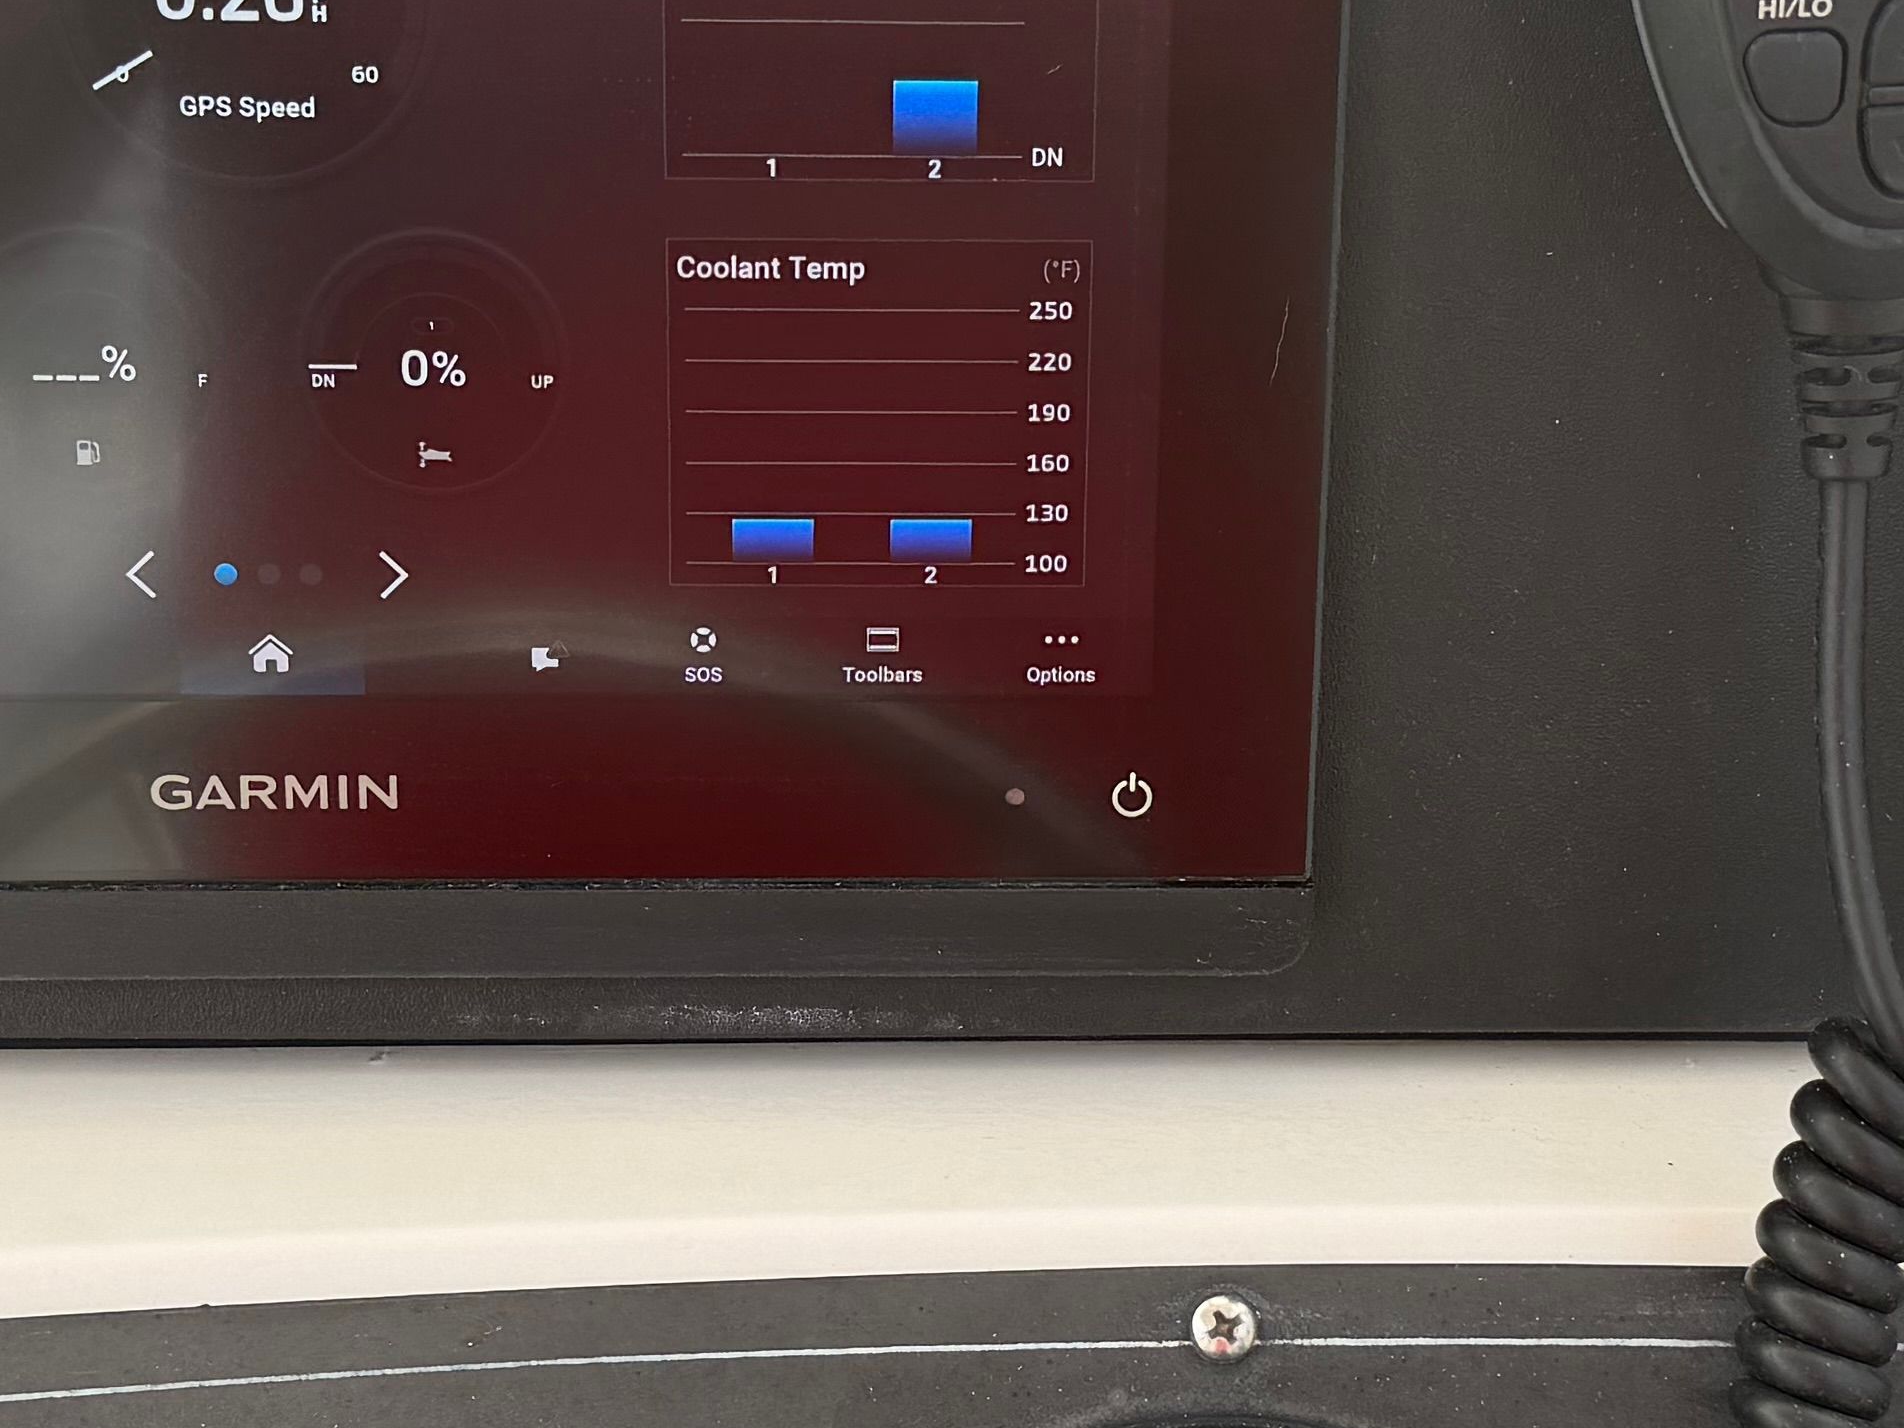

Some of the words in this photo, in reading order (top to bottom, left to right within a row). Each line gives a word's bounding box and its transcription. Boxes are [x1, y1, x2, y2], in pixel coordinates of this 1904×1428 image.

[352, 66, 378, 84] 60
[180, 97, 231, 117] GPS
[240, 97, 315, 122] Speed
[1032, 148, 1064, 168] DN
[676, 257, 780, 280] Coolant
[790, 257, 865, 285] Temp
[1029, 302, 1072, 321] 250
[312, 374, 335, 389] DN
[401, 350, 466, 387] 0%
[531, 375, 553, 389] UP
[1025, 555, 1067, 573] 100
[685, 667, 722, 683] SOS
[843, 667, 923, 684] Toolbars
[1026, 667, 1096, 687] Options
[150, 773, 399, 811] GARMIN
